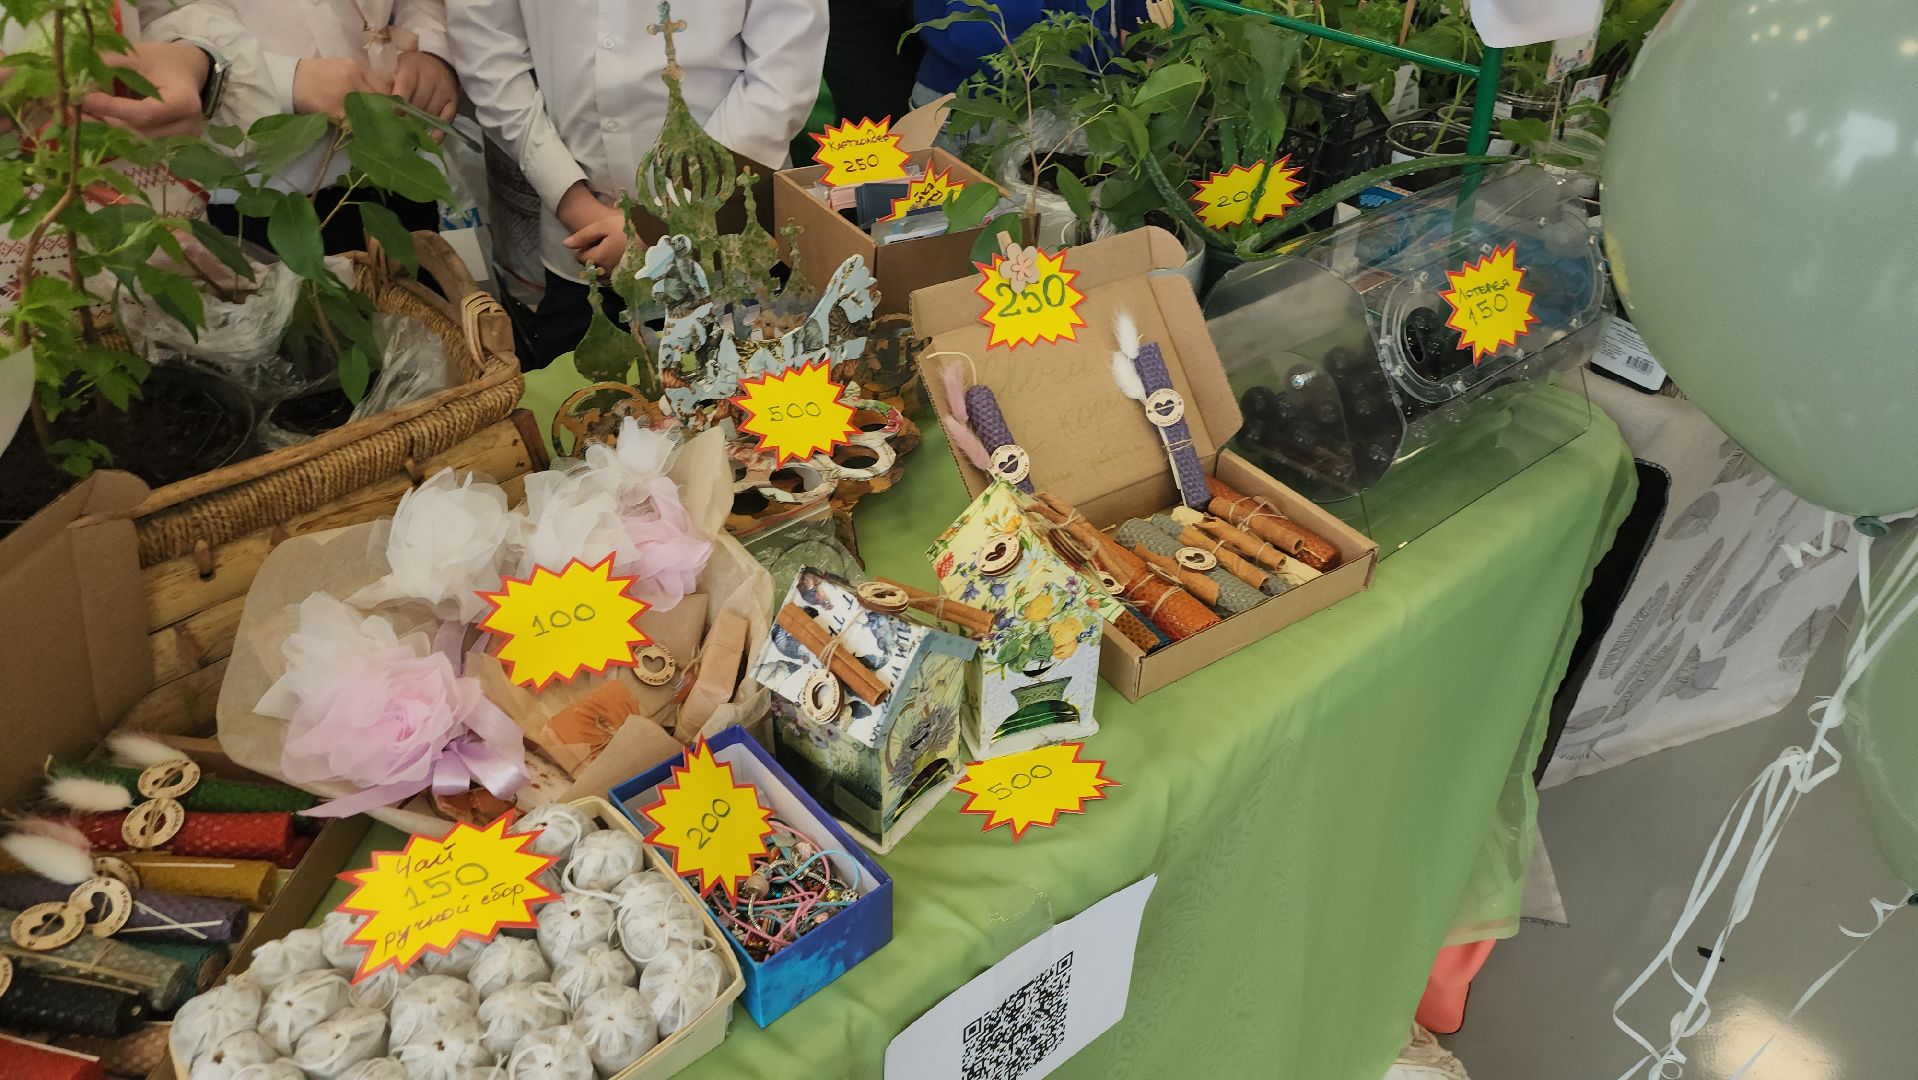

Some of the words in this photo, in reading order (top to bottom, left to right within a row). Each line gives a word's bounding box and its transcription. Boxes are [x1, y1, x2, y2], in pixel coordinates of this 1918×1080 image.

[843, 154, 879, 172] 250
[1217, 188, 1266, 207] 200
[996, 274, 1066, 317] 250
[1468, 294, 1508, 326] 150
[768, 402, 821, 421] 500
[532, 603, 595, 637] 100
[987, 765, 1053, 800] 500
[686, 798, 731, 850] 200
[396, 843, 456, 878] Чай
[404, 863, 488, 910] 150
[383, 895, 470, 956] ручной
